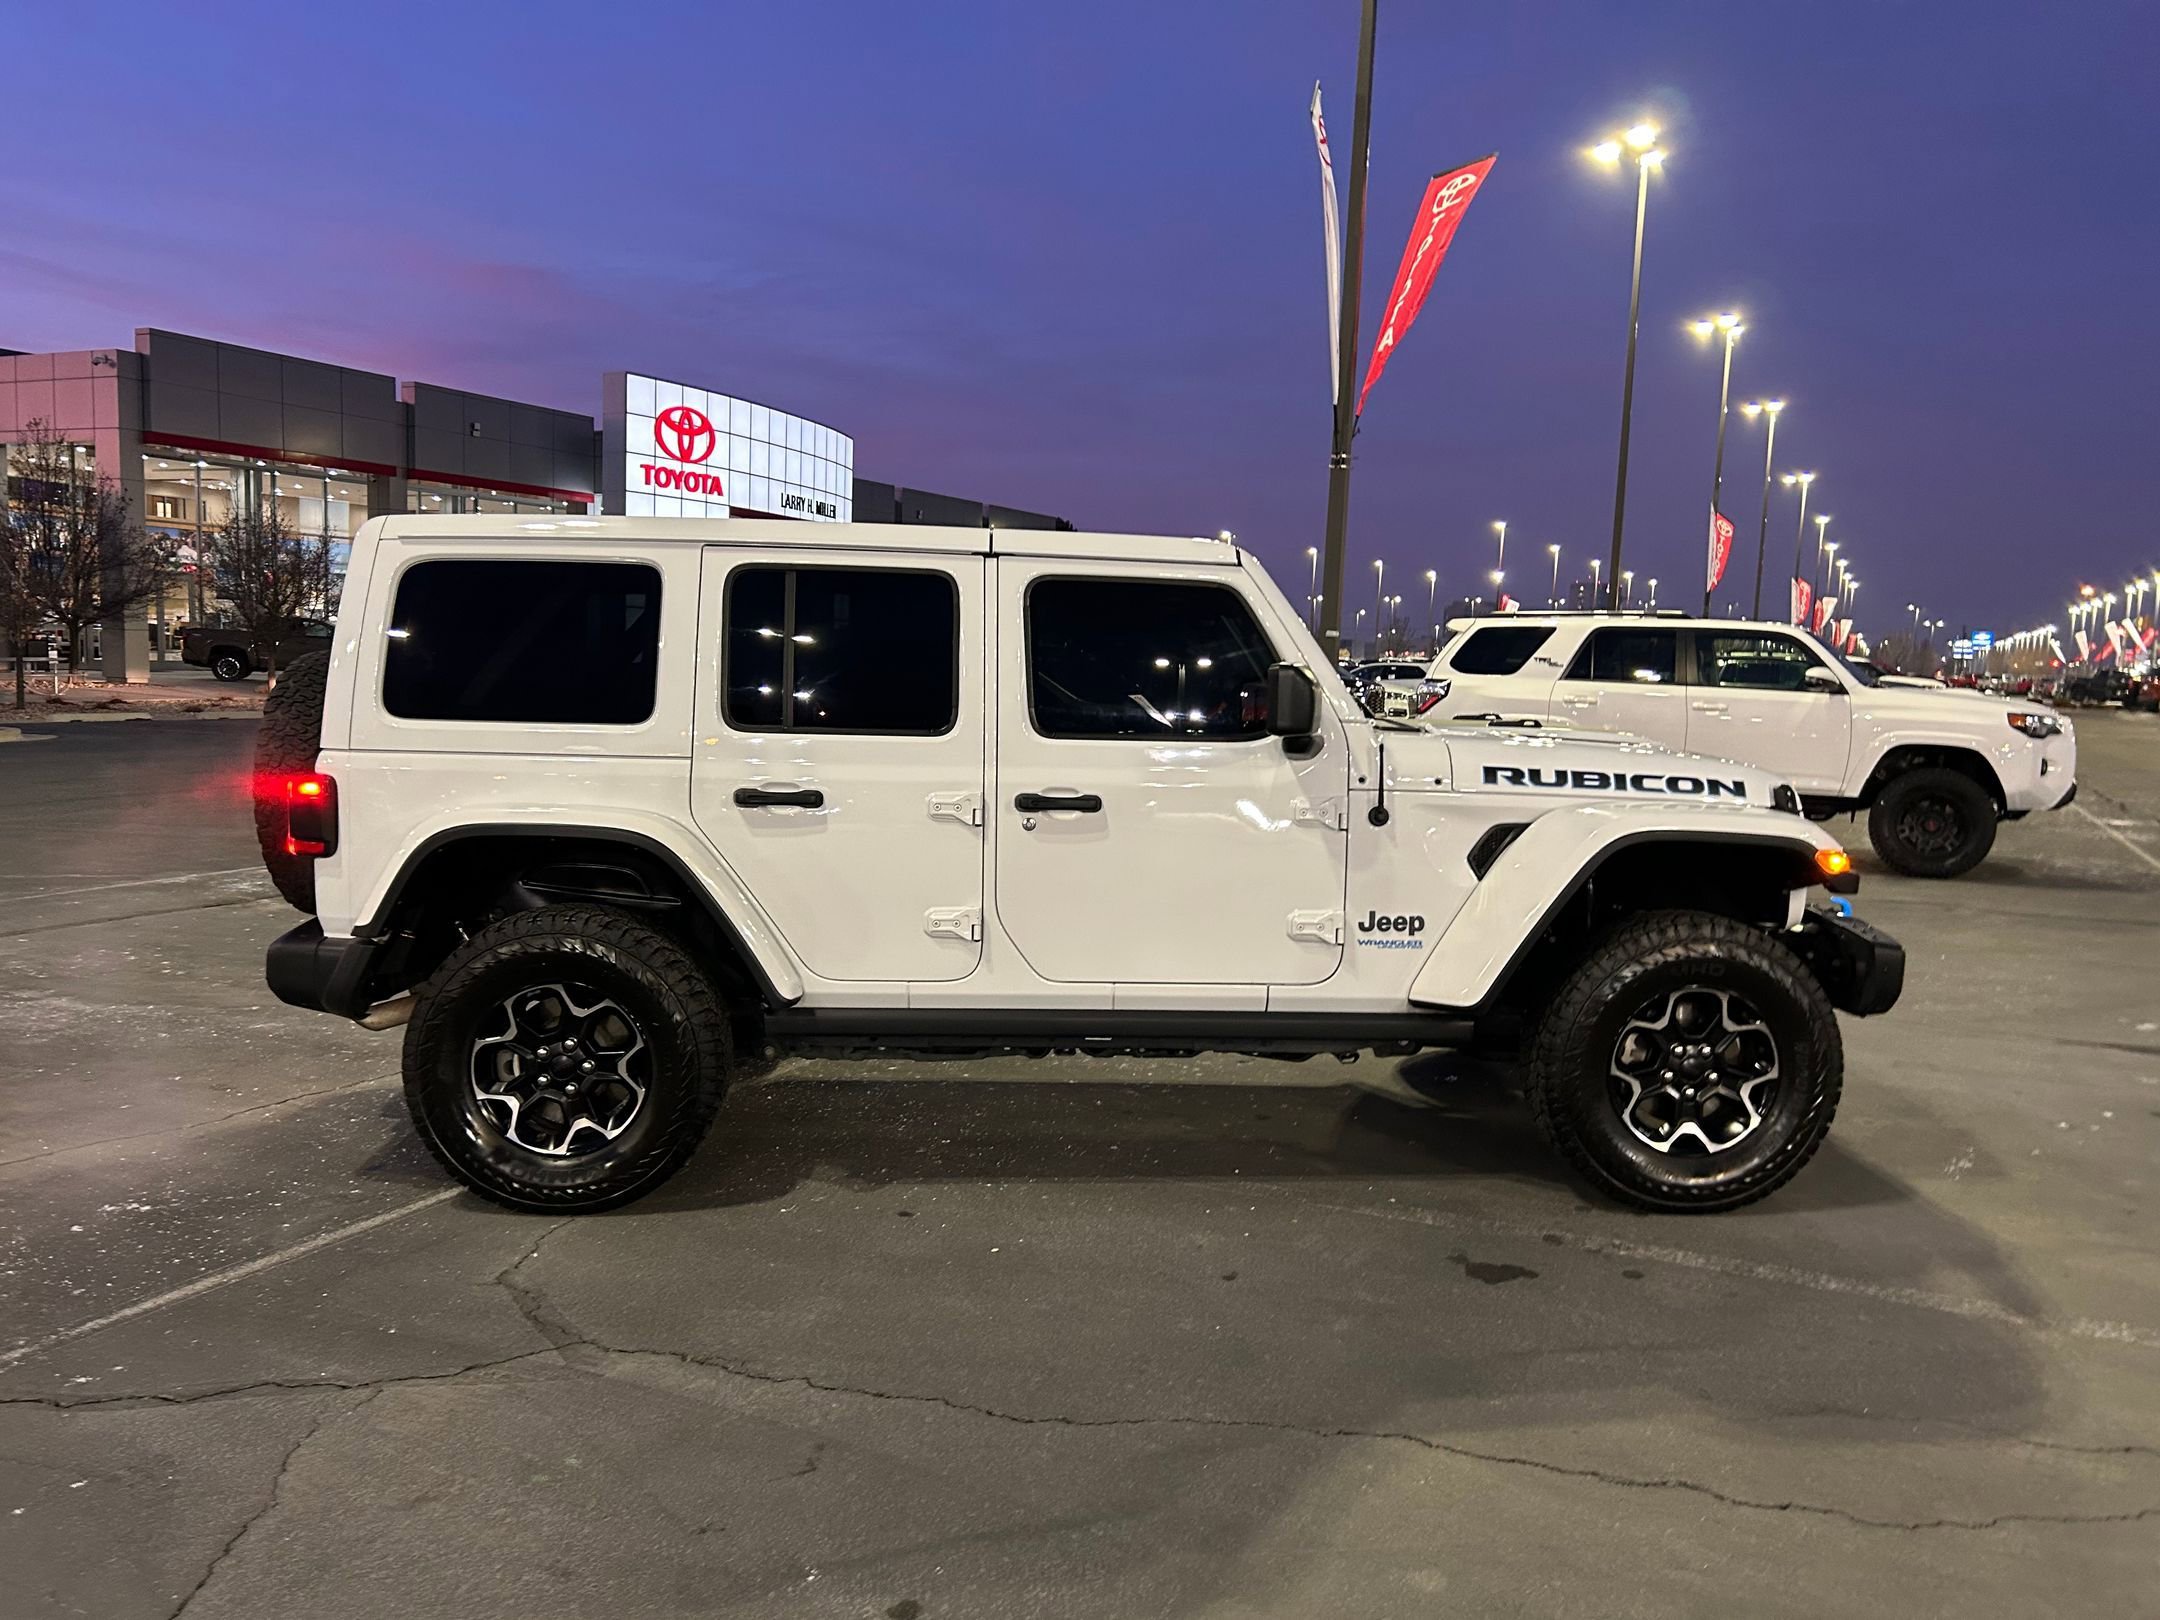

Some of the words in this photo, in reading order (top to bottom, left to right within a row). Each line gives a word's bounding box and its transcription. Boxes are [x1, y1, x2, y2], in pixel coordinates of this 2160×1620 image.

[640, 464, 724, 496] TOYOTA
[781, 492, 805, 512] LARRY
[815, 500, 837, 519] MILLER
[1483, 766, 1747, 798] RUBICON
[1358, 910, 1425, 936] Jeep
